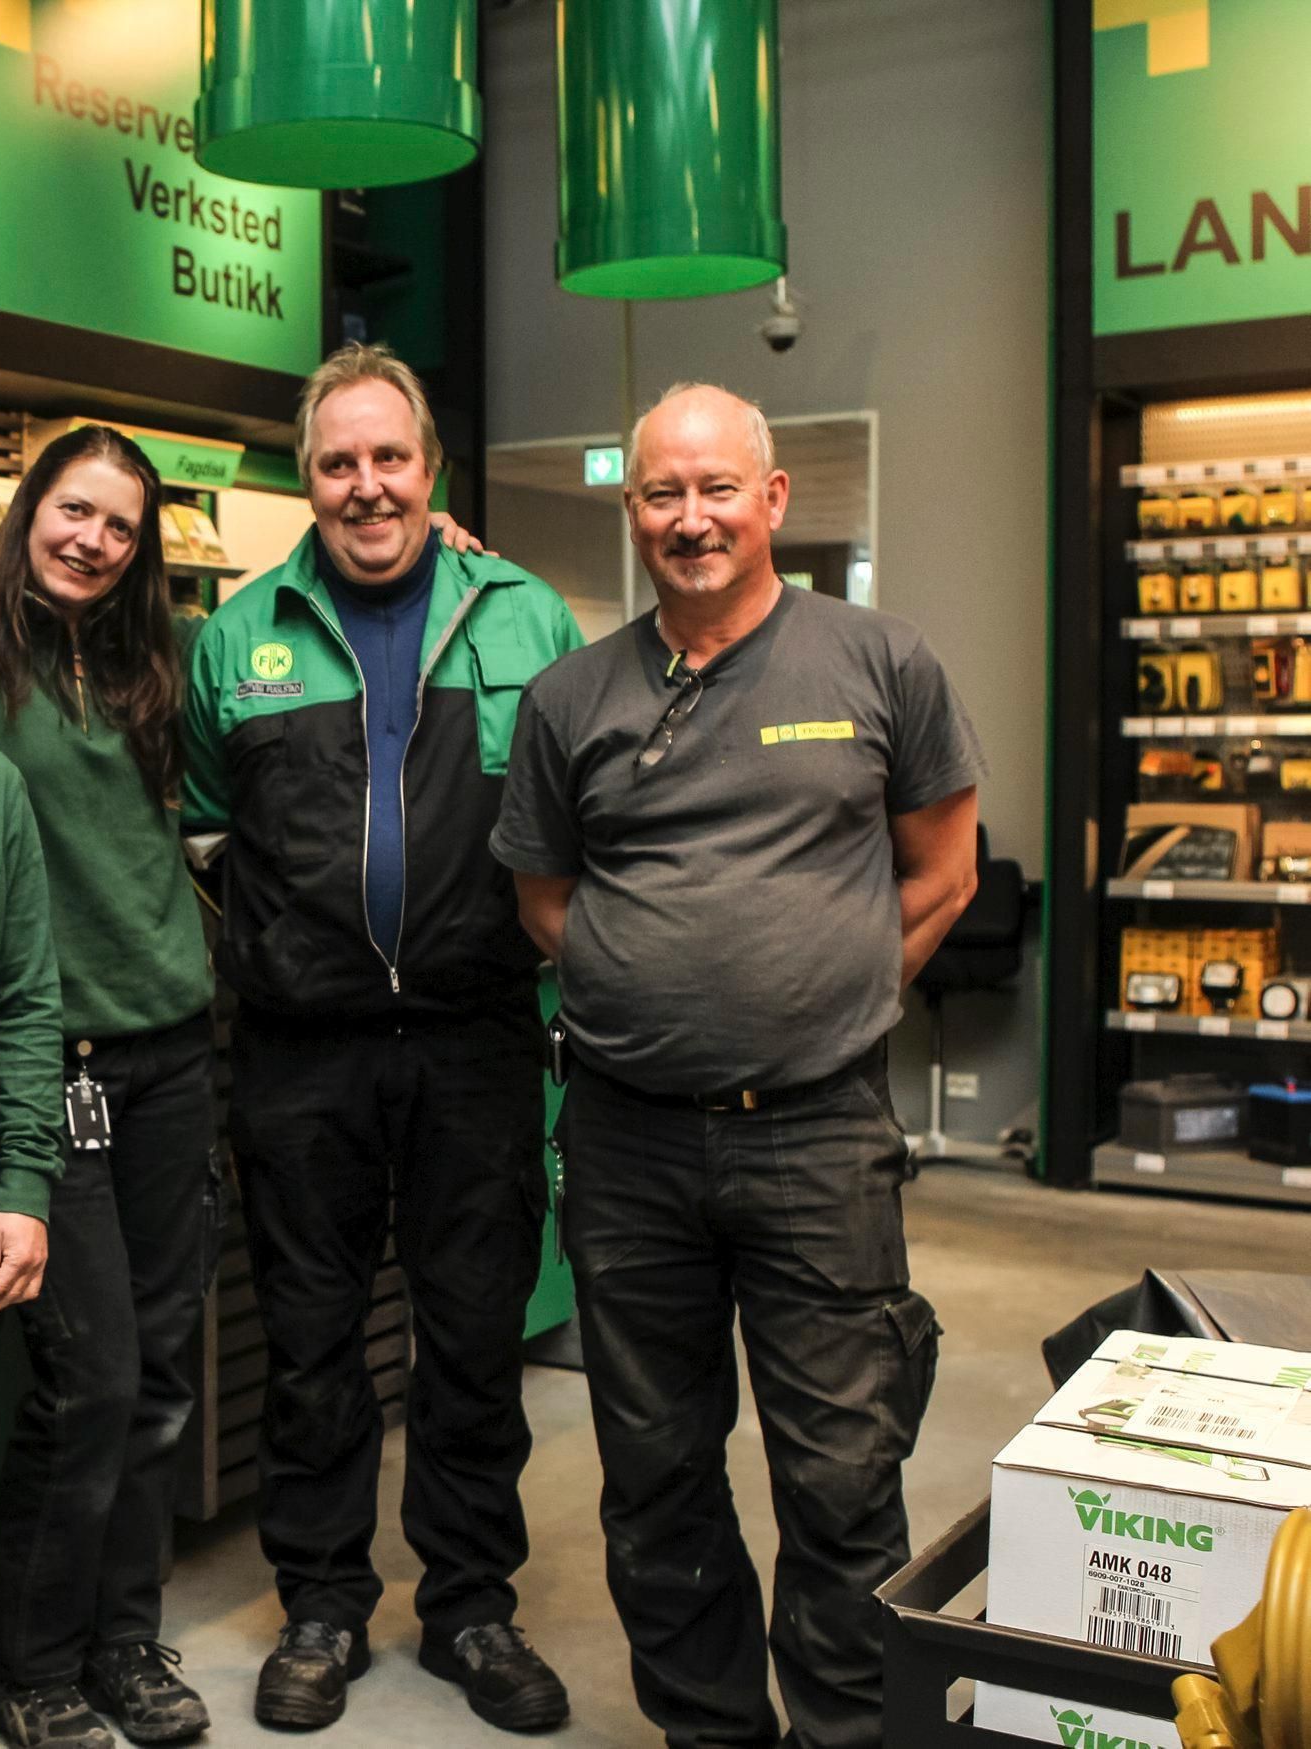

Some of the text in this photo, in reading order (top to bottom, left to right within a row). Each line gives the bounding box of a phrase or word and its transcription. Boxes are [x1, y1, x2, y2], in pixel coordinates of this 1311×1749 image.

[33, 52, 194, 154] Reserve
[124, 157, 282, 251] Verksted
[1115, 184, 1311, 280] LAN
[172, 245, 285, 321] Butikk
[1075, 1503, 1213, 1552] VIKING
[1088, 1550, 1172, 1584] AMK 048
[1088, 1570, 1145, 1588] 6909-007-1028
[1057, 1722, 1166, 1749] VIK
